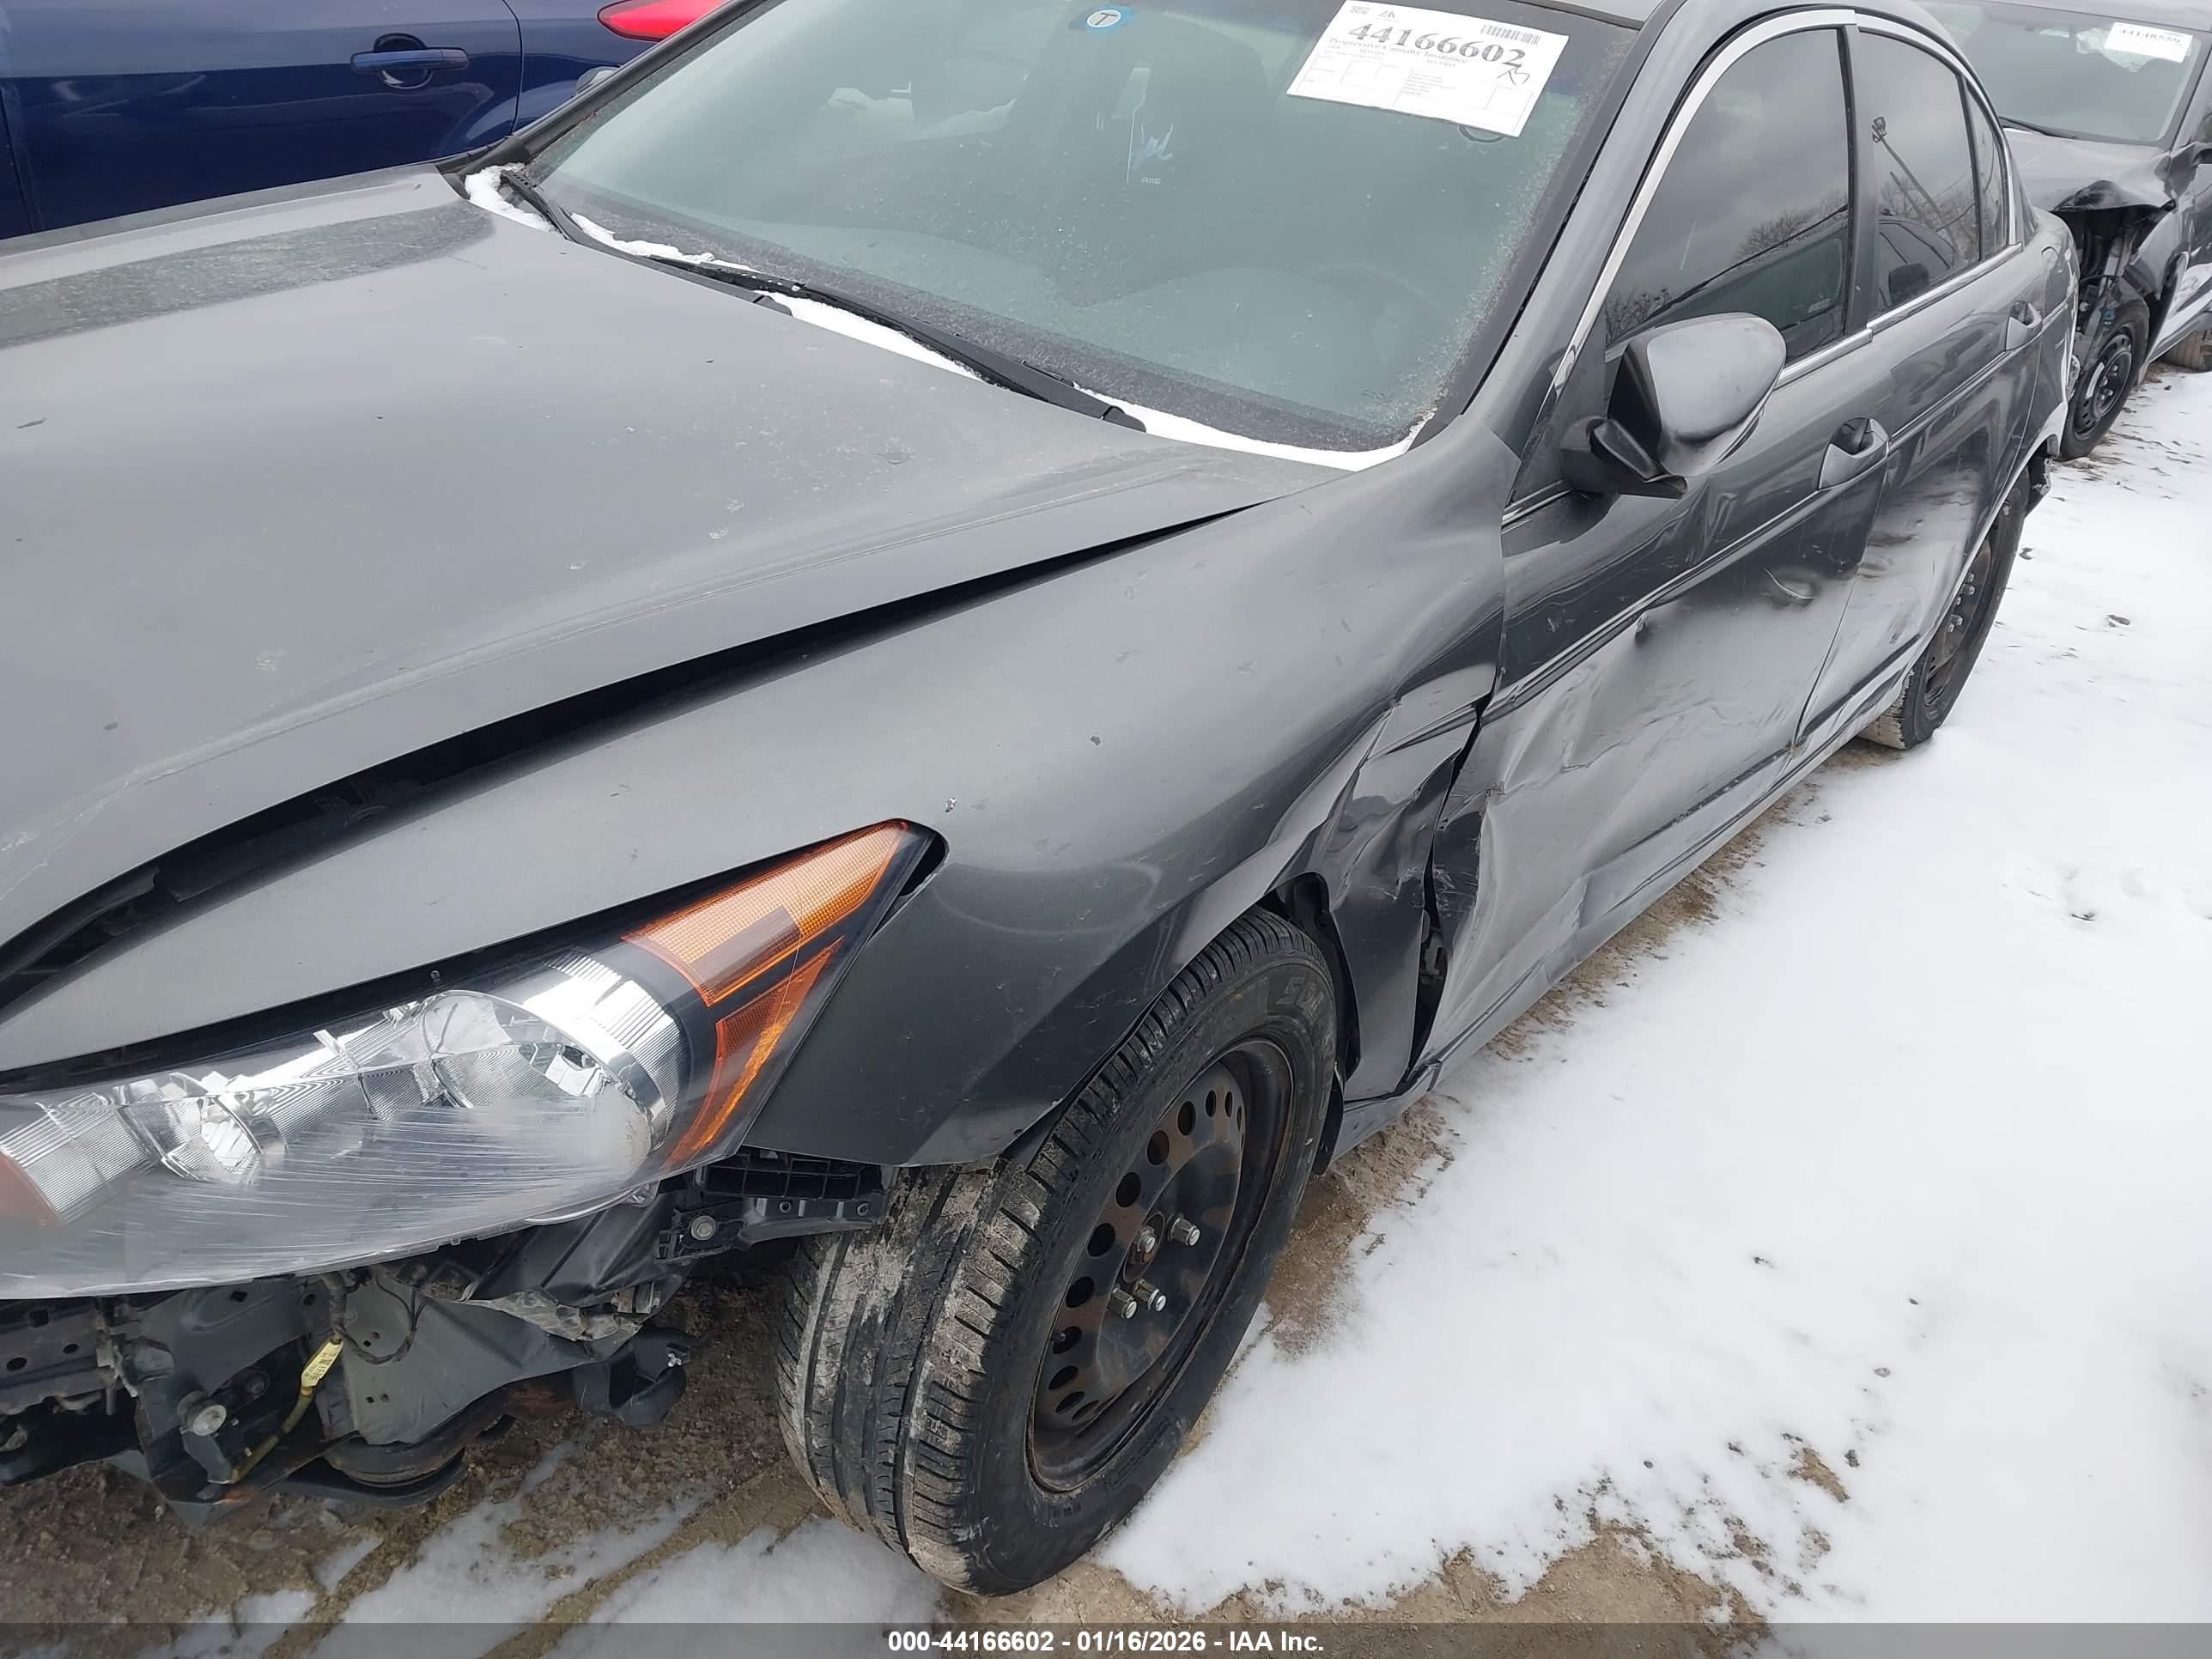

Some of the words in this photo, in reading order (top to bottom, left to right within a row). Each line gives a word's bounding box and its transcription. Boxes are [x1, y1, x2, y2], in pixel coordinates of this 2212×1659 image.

[1095, 12, 1117, 26] T
[1329, 37, 1381, 49] Progressive
[1382, 45, 1421, 57] Casualty
[1424, 51, 1469, 64] Insurance
[1348, 23, 1526, 66] 44166602
